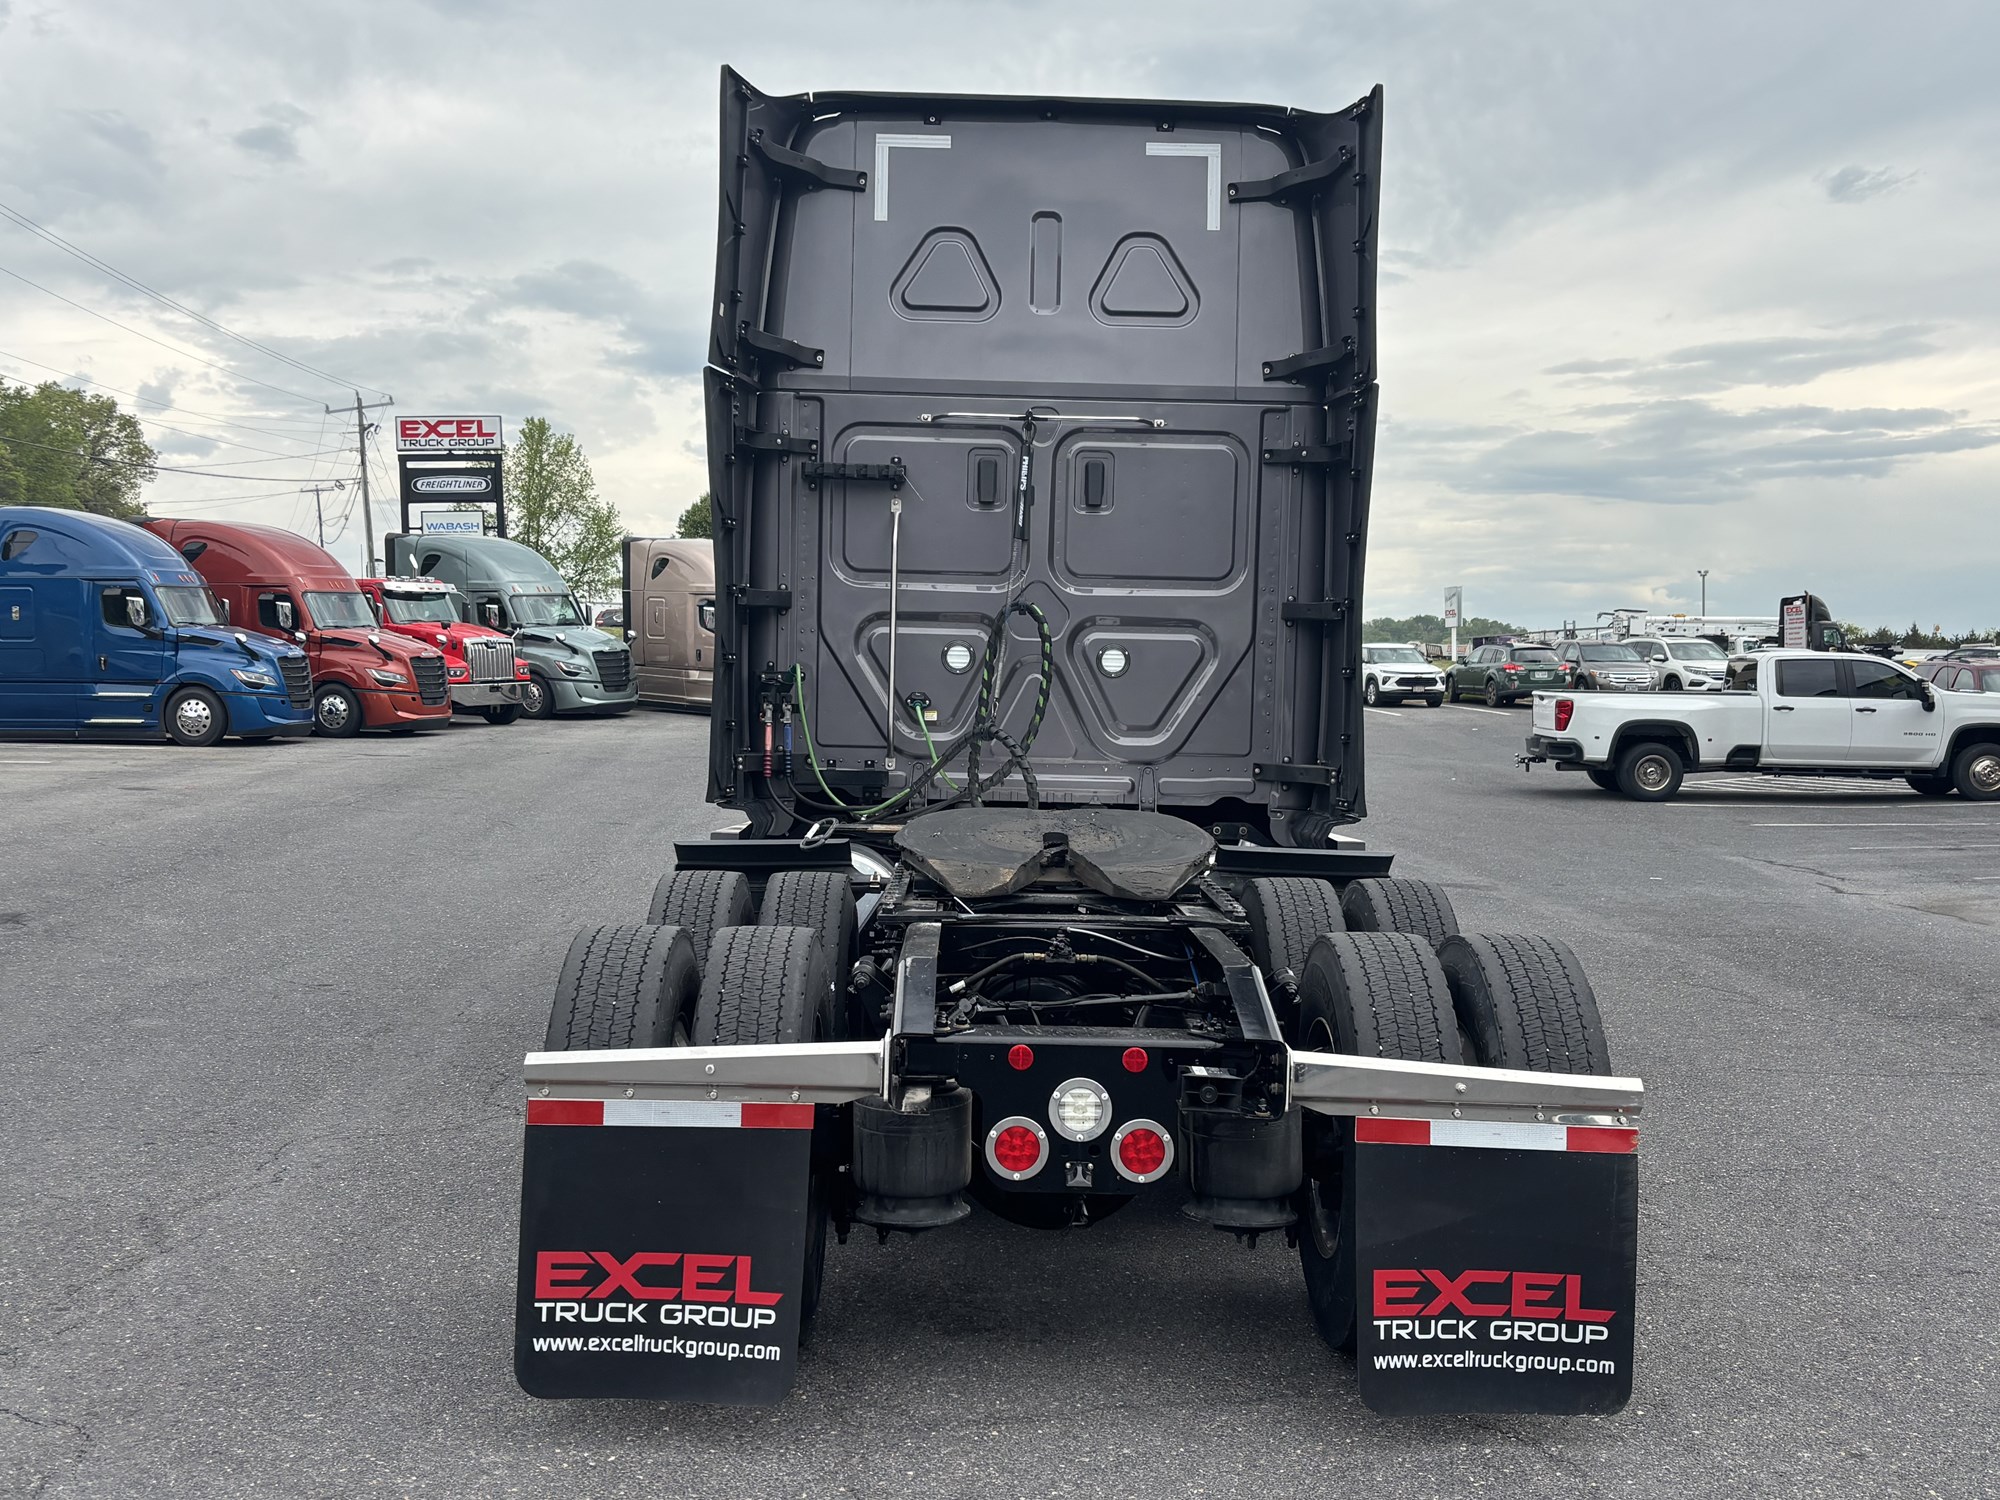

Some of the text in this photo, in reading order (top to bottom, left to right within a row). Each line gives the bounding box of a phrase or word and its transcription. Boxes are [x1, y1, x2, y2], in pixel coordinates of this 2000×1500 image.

[400, 420, 497, 438] EXCEL
[400, 439, 495, 447] TRUCK GROUP
[420, 480, 483, 489] FREIGHTLINER
[426, 522, 480, 530] WABASH
[535, 1251, 784, 1305] EXCEL
[1373, 1269, 1616, 1323] EXCEL
[534, 1302, 776, 1329] TRUCK GROUP
[1373, 1320, 1609, 1344] TRUCK GROUP
[532, 1334, 781, 1361] www.exceltruckgroup.com
[1373, 1350, 1615, 1375] www.exceltruckgroup.com
